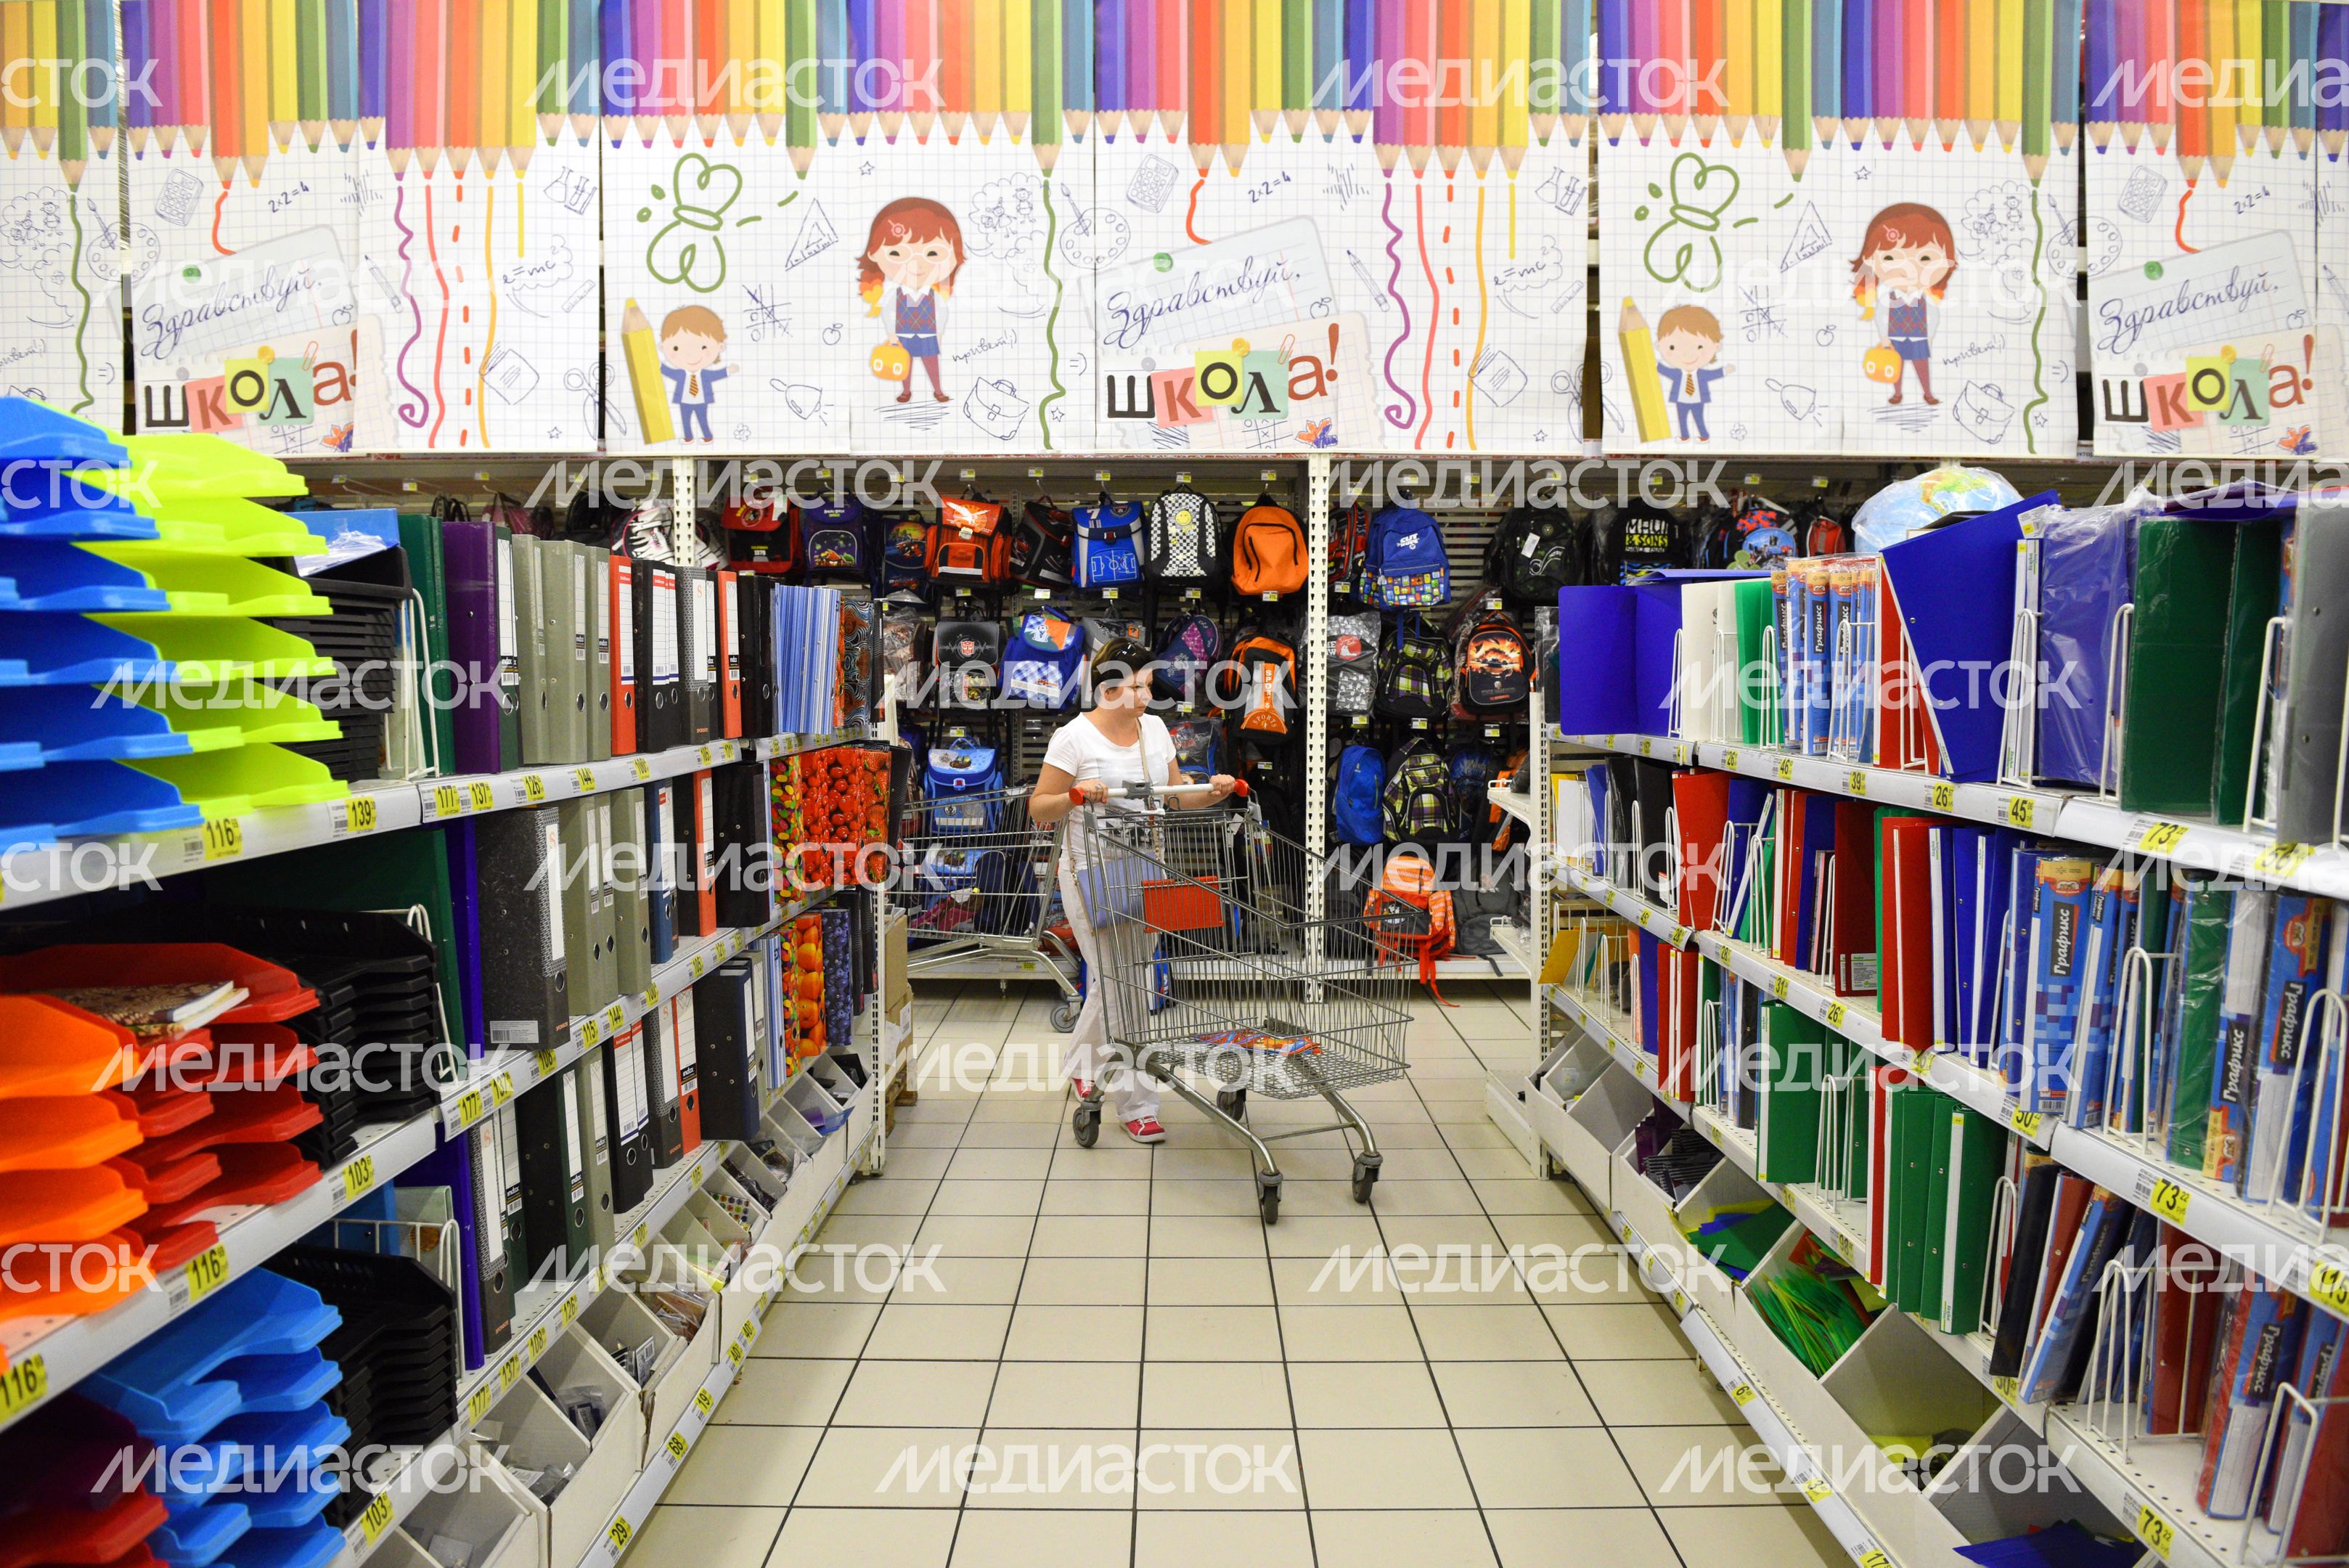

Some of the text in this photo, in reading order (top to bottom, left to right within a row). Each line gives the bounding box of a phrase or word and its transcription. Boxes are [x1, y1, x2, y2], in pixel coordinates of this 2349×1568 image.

[1252, 714, 1278, 727] SPORTS
[1780, 759, 1789, 774] 46
[471, 783, 486, 805] 137
[525, 776, 540, 796] 126
[1851, 772, 1861, 791] 39
[437, 785, 454, 808] 177
[1935, 785, 1948, 807] 26
[352, 800, 371, 827] 139
[2011, 800, 2027, 822] 45
[205, 820, 234, 849] 116
[2148, 823, 2173, 844] 73
[2054, 908, 2071, 975] Графикс
[1776, 978, 1784, 995] 31
[1828, 1003, 1839, 1023] 26
[2275, 982, 2303, 1061] Графикс
[2221, 1029, 2245, 1102] Графикс
[462, 1095, 478, 1120] 177
[348, 1161, 369, 1189] 103
[2156, 1179, 2178, 1212] 73
[2180, 1191, 2189, 1202] 22
[192, 1249, 220, 1289] 116
[502, 1357, 516, 1386] 137
[2254, 1326, 2280, 1394] Графикс
[471, 1389, 488, 1416] 177
[669, 1437, 683, 1455] 68
[366, 1501, 387, 1531] 103
[2144, 1510, 2162, 1545] 73
[612, 1525, 627, 1545] 29
